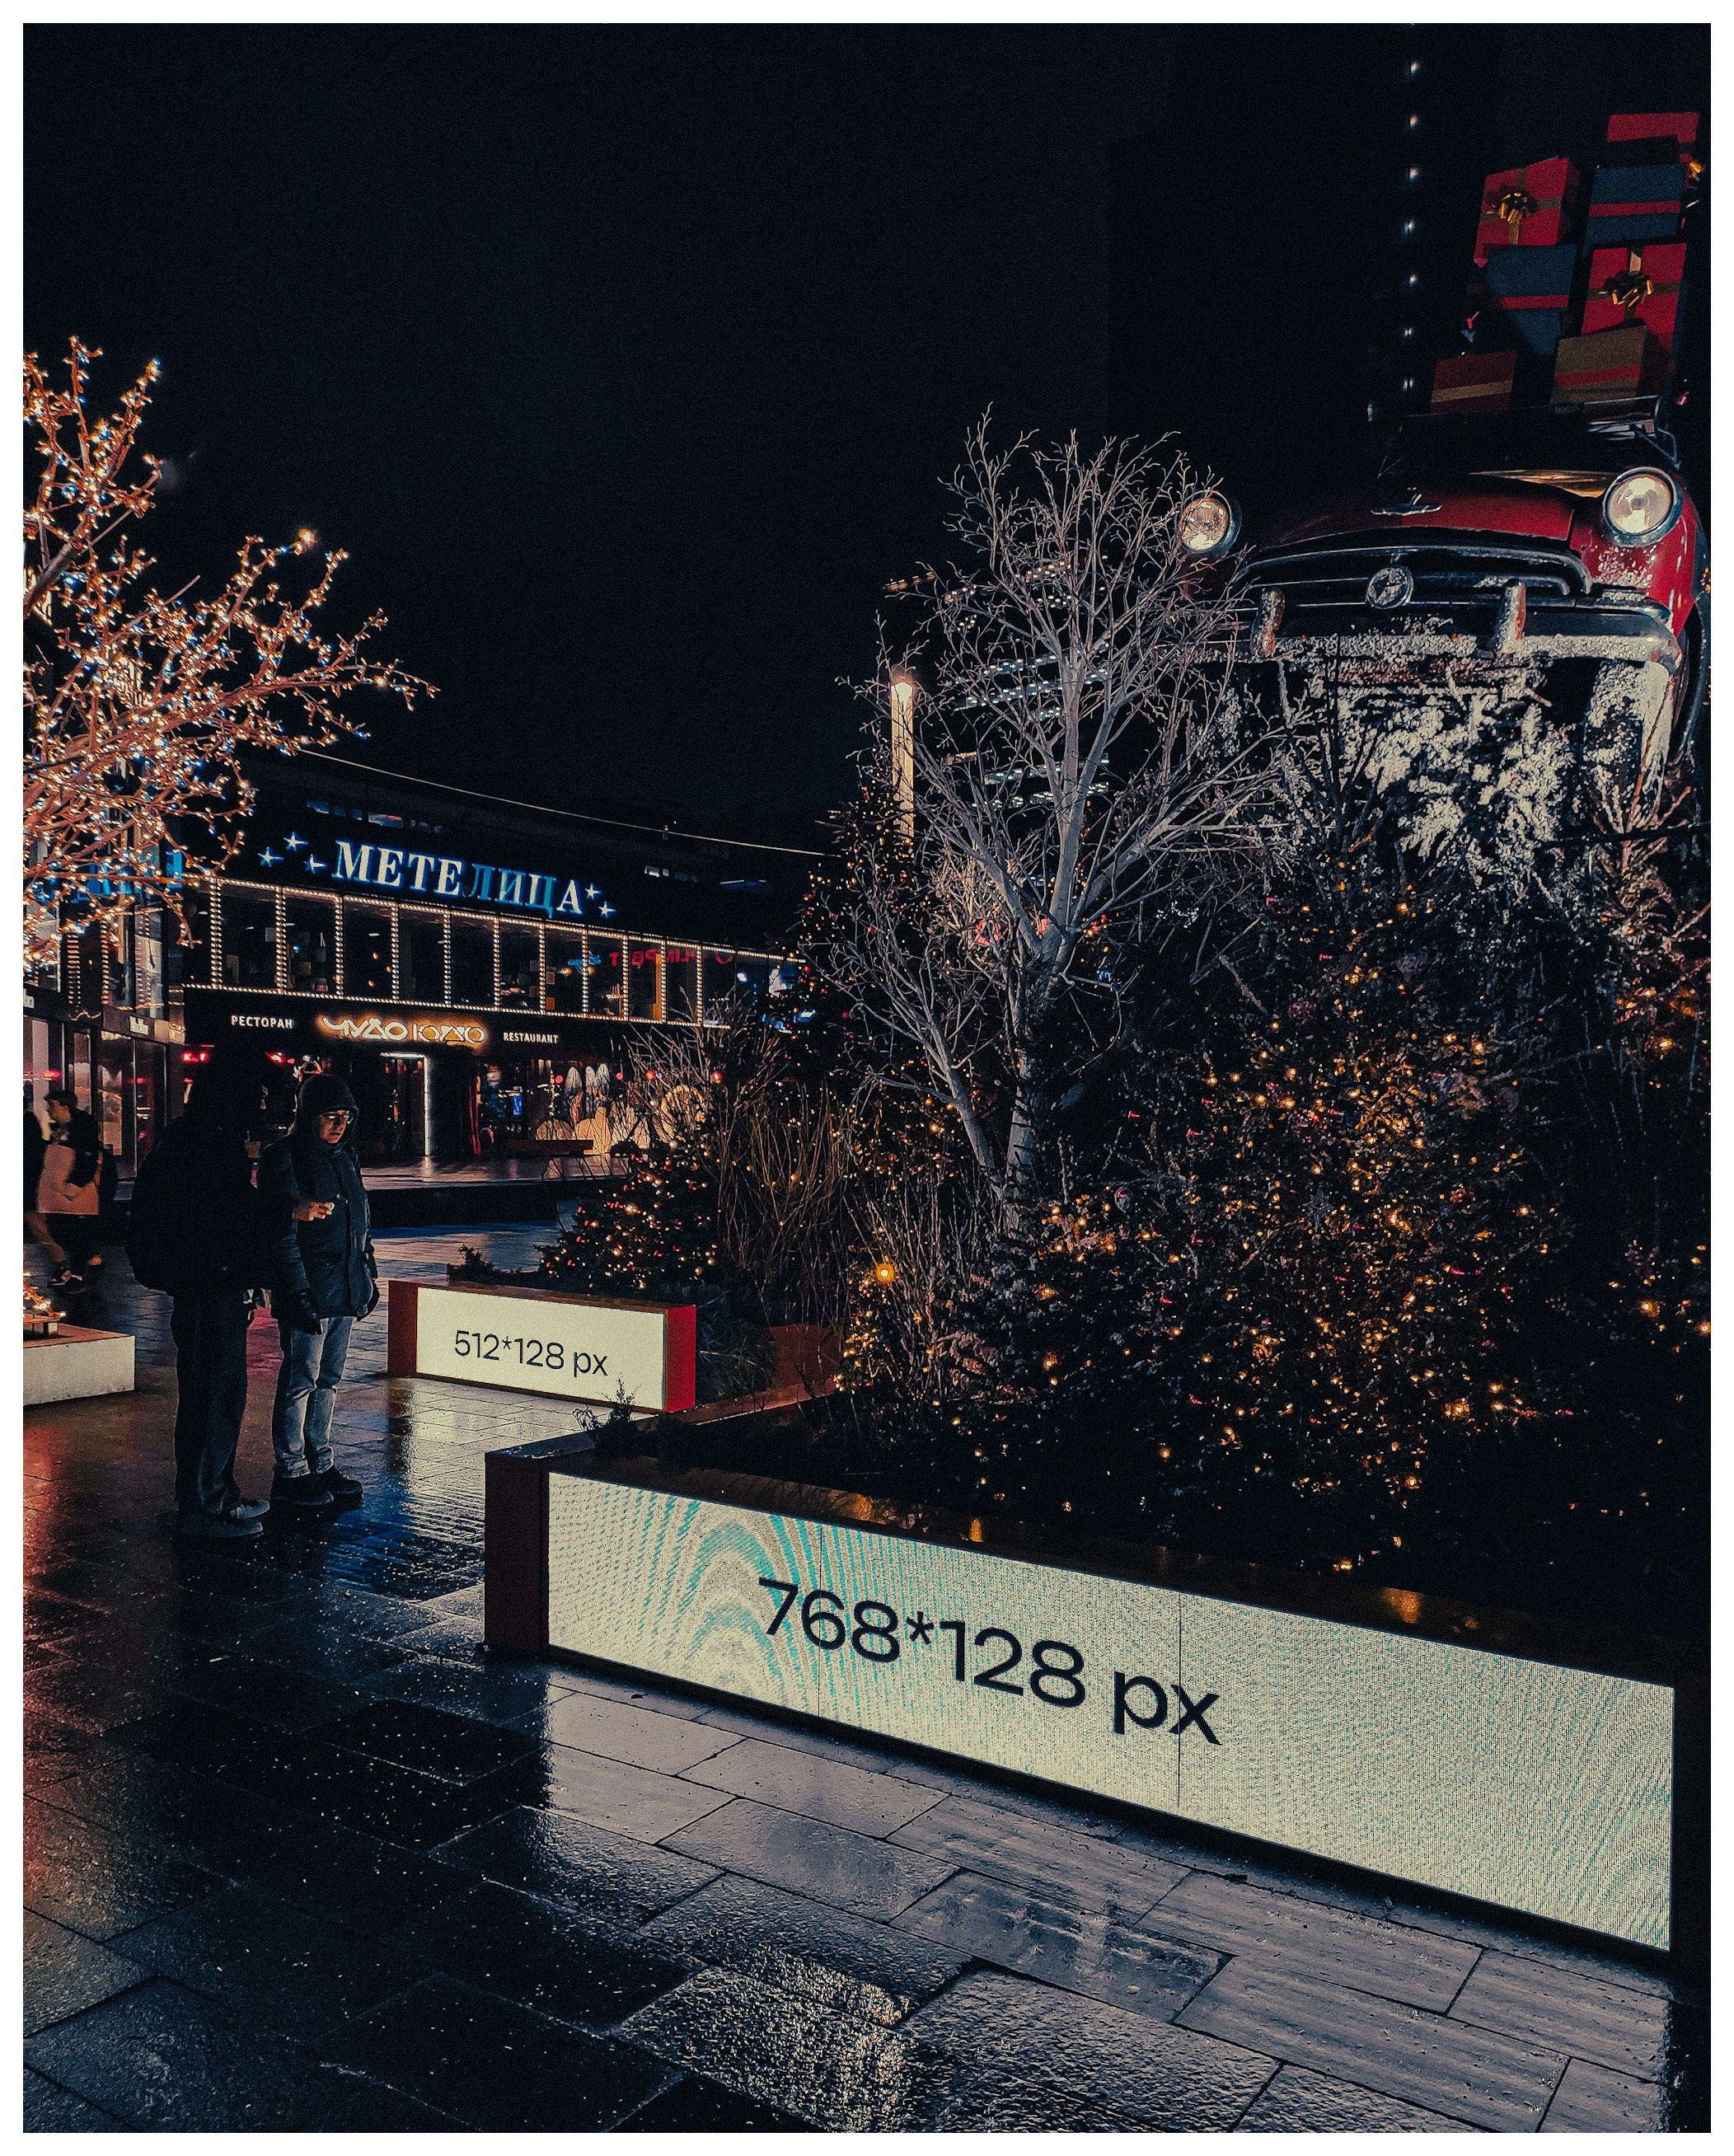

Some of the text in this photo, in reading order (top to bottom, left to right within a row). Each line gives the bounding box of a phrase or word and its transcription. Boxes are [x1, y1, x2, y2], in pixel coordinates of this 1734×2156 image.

[331, 839, 583, 919] МЕТЕЛИЦА
[231, 1015, 293, 1029] РЕСТОРАН
[322, 1018, 408, 1041] ЧУДО
[503, 1032, 559, 1043] RESTAURANT
[574, 1351, 608, 1377] px
[1113, 1671, 1223, 1746] px
